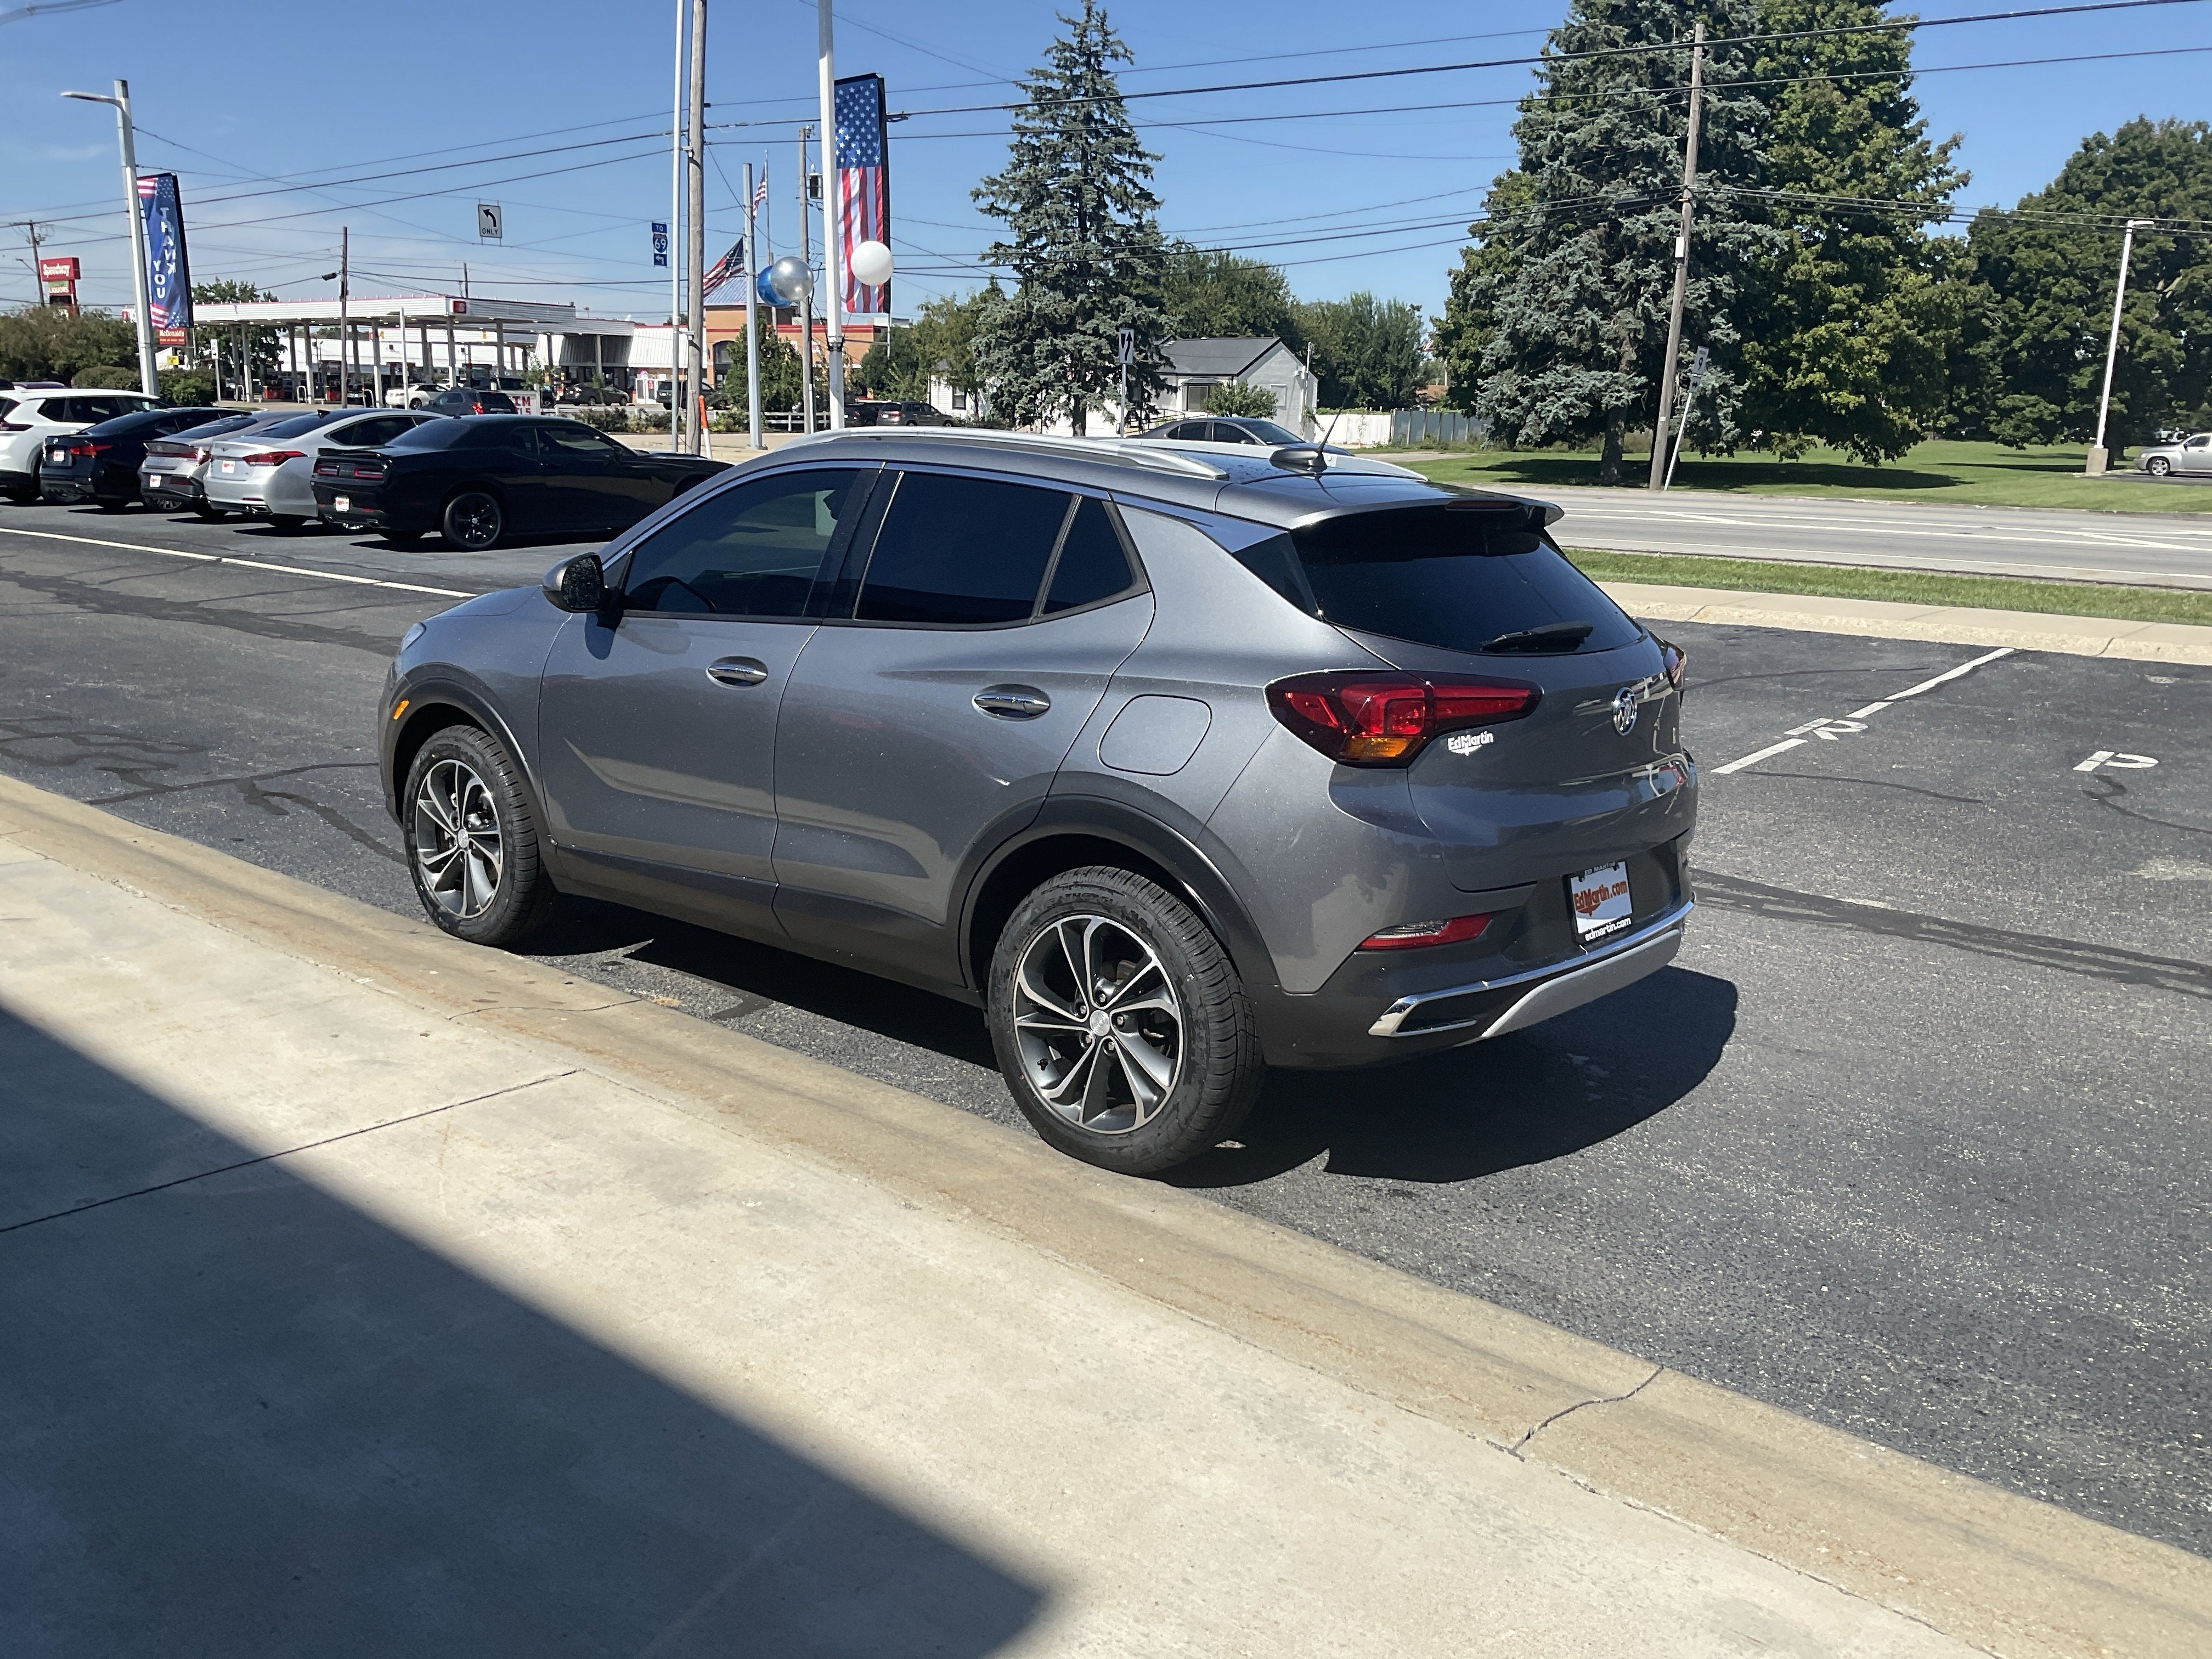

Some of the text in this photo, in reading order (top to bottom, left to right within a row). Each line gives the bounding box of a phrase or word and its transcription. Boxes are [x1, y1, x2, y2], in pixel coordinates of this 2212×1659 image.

[654, 238, 666, 249] 69
[1697, 357, 1703, 370] 9
[1783, 718, 1869, 740] R
[2072, 751, 2159, 772] P
[1573, 881, 1628, 911] EdMartin.com
[1585, 917, 1631, 941] edmartin.com
